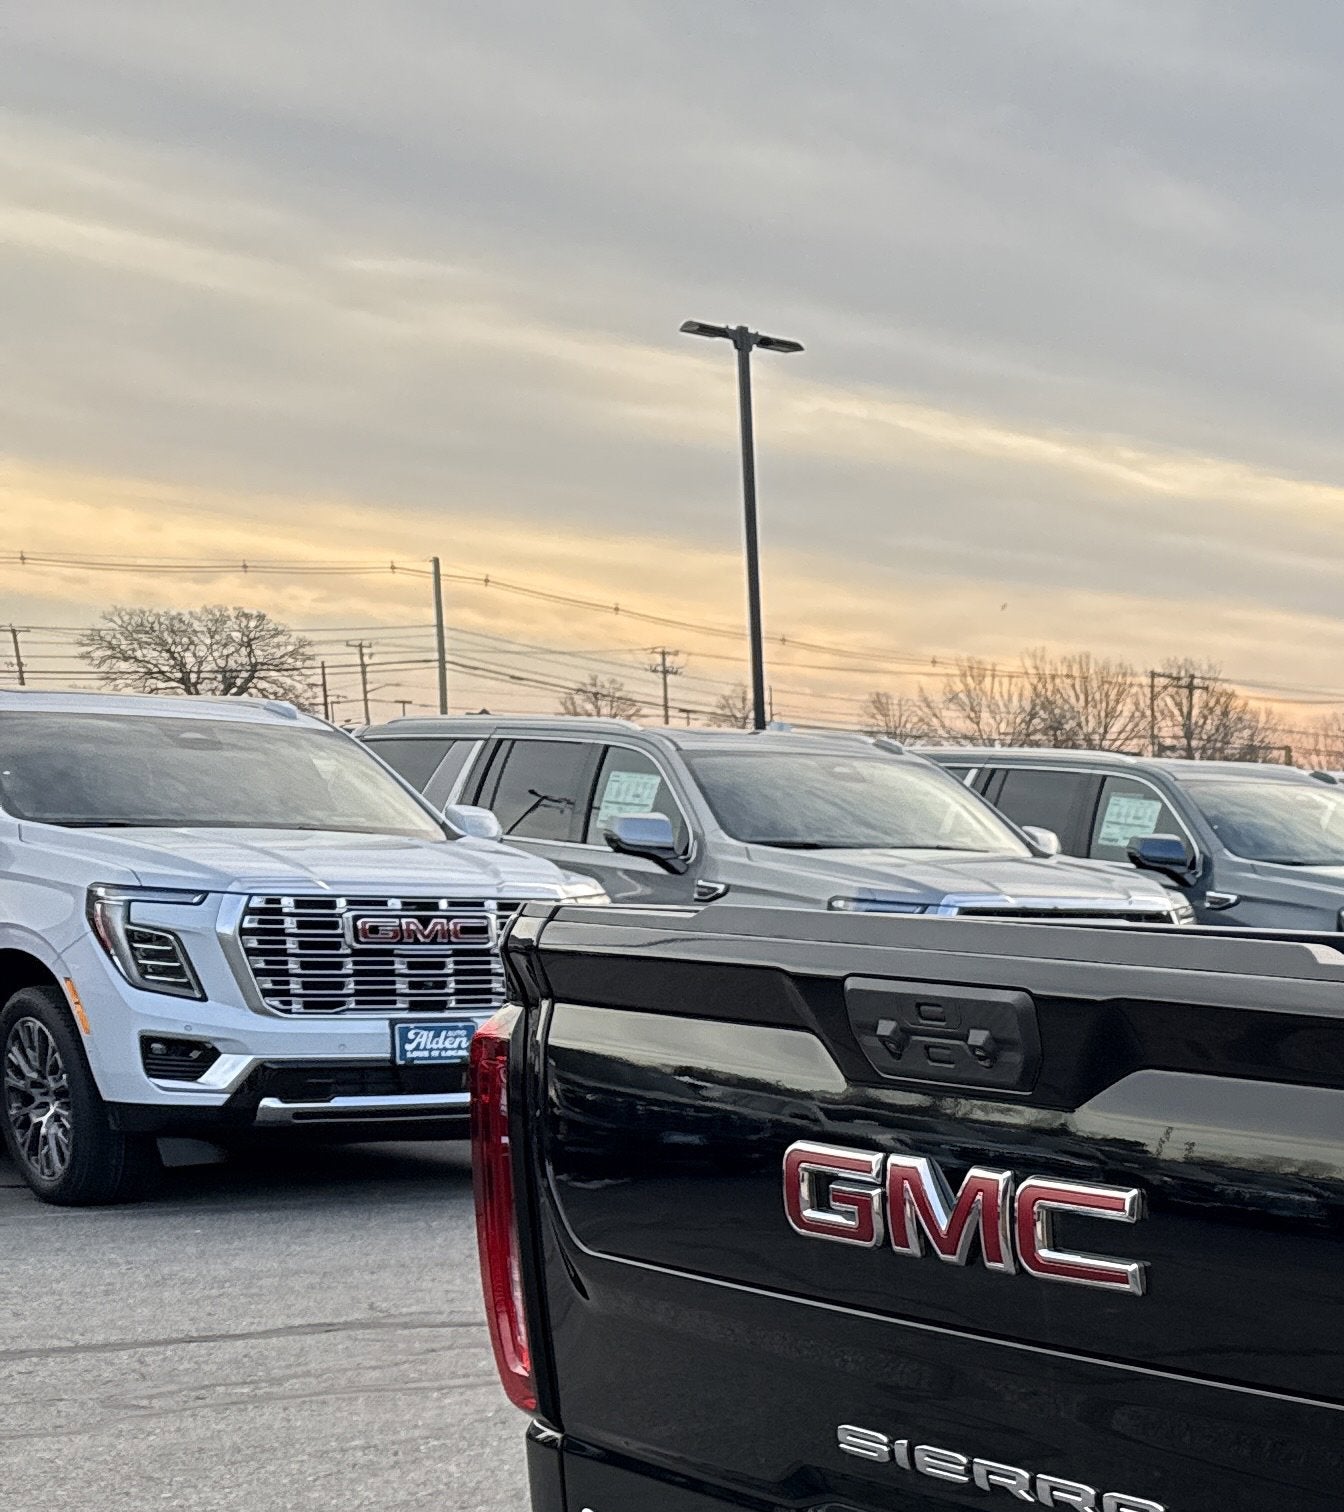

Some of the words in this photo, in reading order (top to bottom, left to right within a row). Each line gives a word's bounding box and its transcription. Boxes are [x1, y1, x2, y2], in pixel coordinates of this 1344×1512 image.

[356, 917, 489, 943] GMC
[404, 1029, 470, 1050] Alden
[783, 1139, 1150, 1298] GMC
